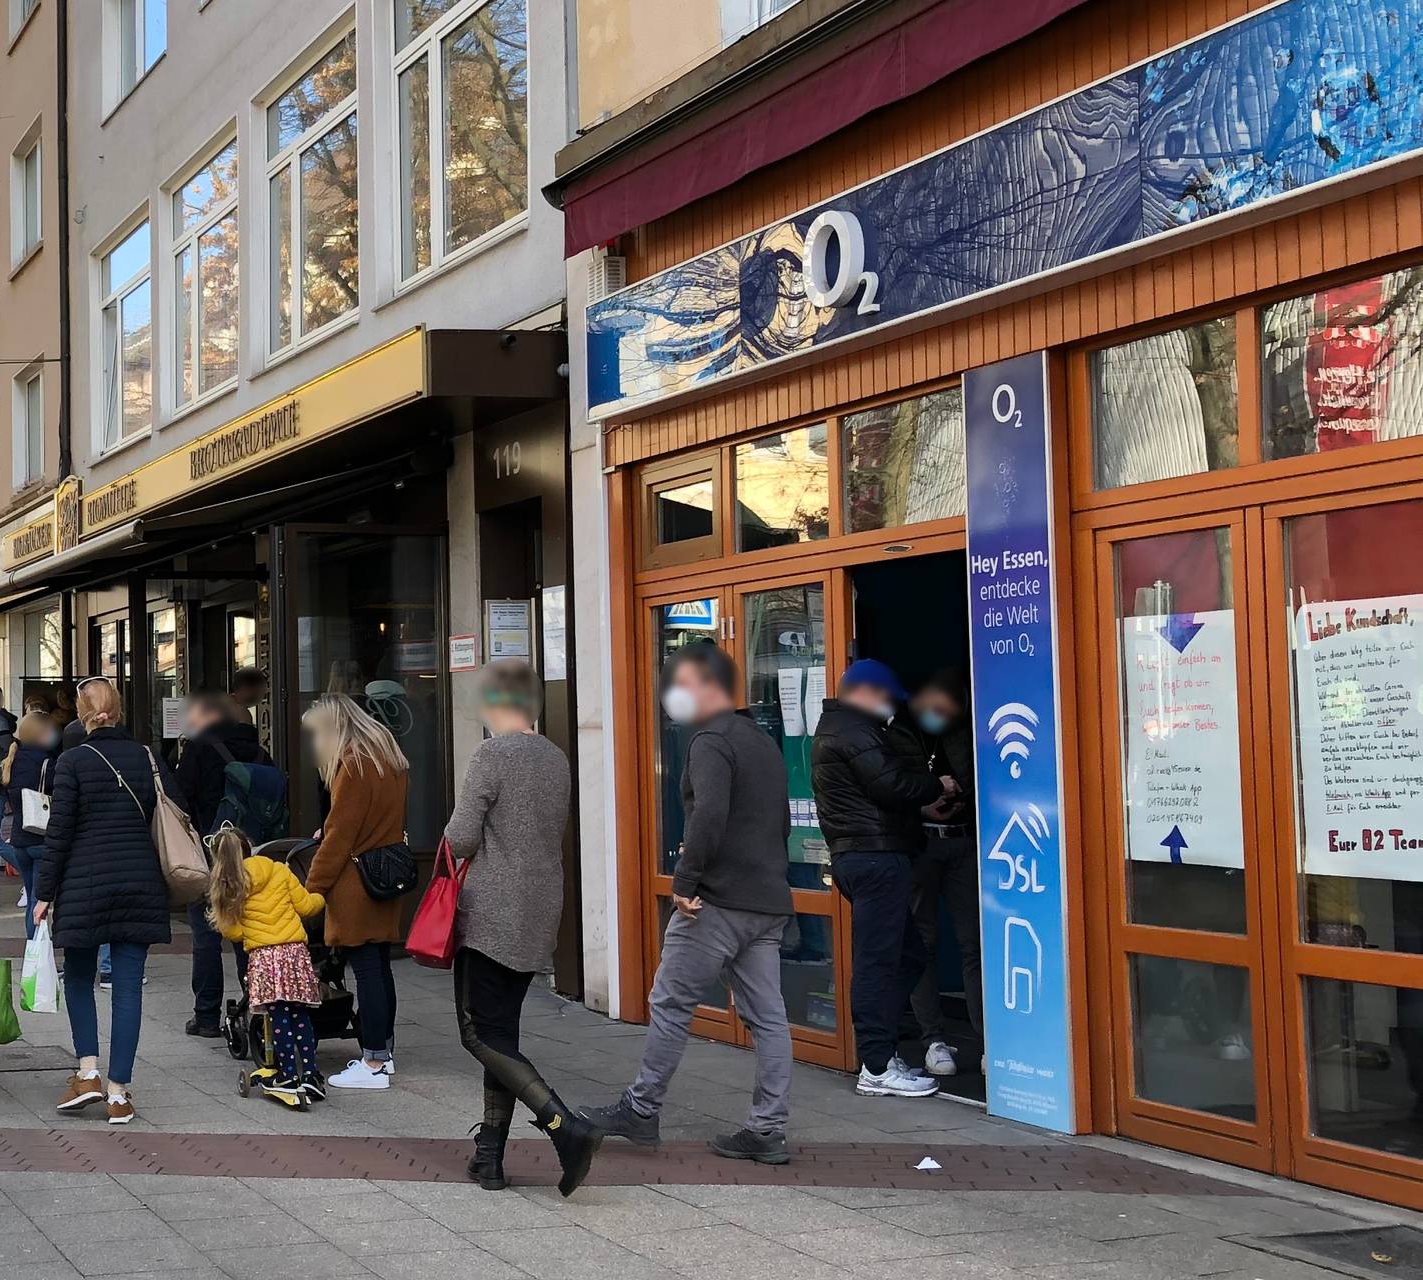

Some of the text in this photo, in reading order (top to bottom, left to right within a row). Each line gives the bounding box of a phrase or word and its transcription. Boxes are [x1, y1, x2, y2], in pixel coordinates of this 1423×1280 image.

[189, 399, 301, 481] BROTAKADEMIE
[493, 441, 522, 480] 119
[971, 549, 1048, 577] Hey Essen,
[980, 576, 1041, 601] entdecke
[983, 606, 1039, 628] die Welt
[1307, 606, 1415, 641] Liebe Kundschaft,
[989, 637, 1014, 655] von
[1328, 829, 1357, 852] Euer
